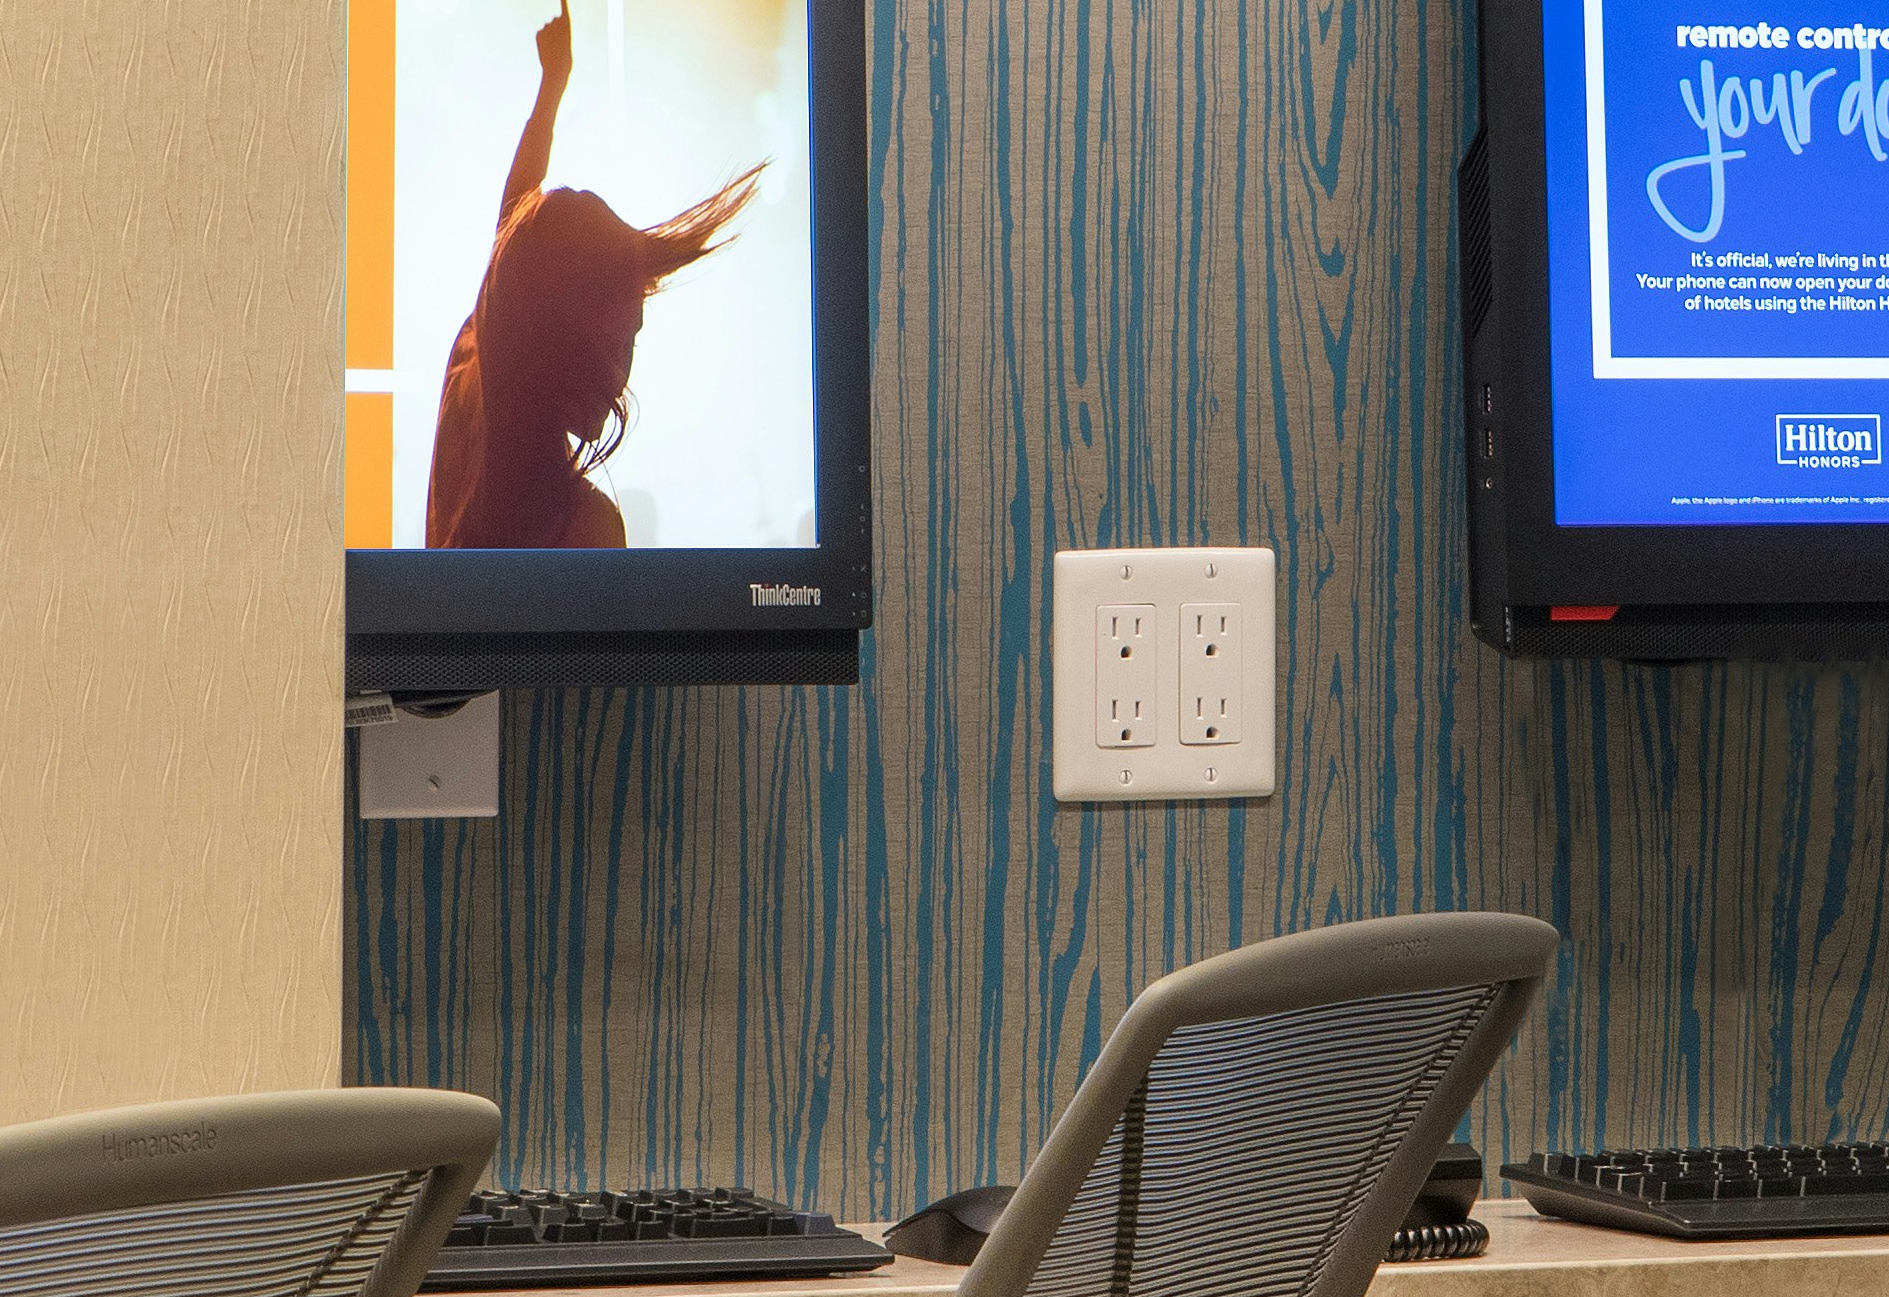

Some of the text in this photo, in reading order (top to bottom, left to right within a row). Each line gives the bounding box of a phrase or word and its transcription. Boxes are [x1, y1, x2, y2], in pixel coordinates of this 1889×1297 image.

[1677, 23, 1790, 48] remote
[1645, 58, 1837, 243] your
[1692, 251, 1713, 267] It's
[1717, 252, 1772, 269] official,
[1776, 252, 1814, 267] we're
[1818, 254, 1858, 271] living
[1863, 254, 1876, 267] in
[1636, 274, 1673, 288] Your
[1677, 274, 1725, 291] phone
[1729, 278, 1756, 288] can
[1760, 278, 1792, 289] now
[1796, 278, 1834, 292] open
[1838, 278, 1872, 292] your
[1685, 295, 1701, 310] of
[1705, 296, 1751, 310] hotels
[1755, 296, 1796, 313] using
[1800, 296, 1826, 310] the
[1830, 296, 1875, 310] Hilton
[1786, 425, 1871, 451] Hilton
[1799, 456, 1859, 468] HONORS
[750, 583, 821, 606] ThinkCentre
[102, 1122, 217, 1162] Humanscale
